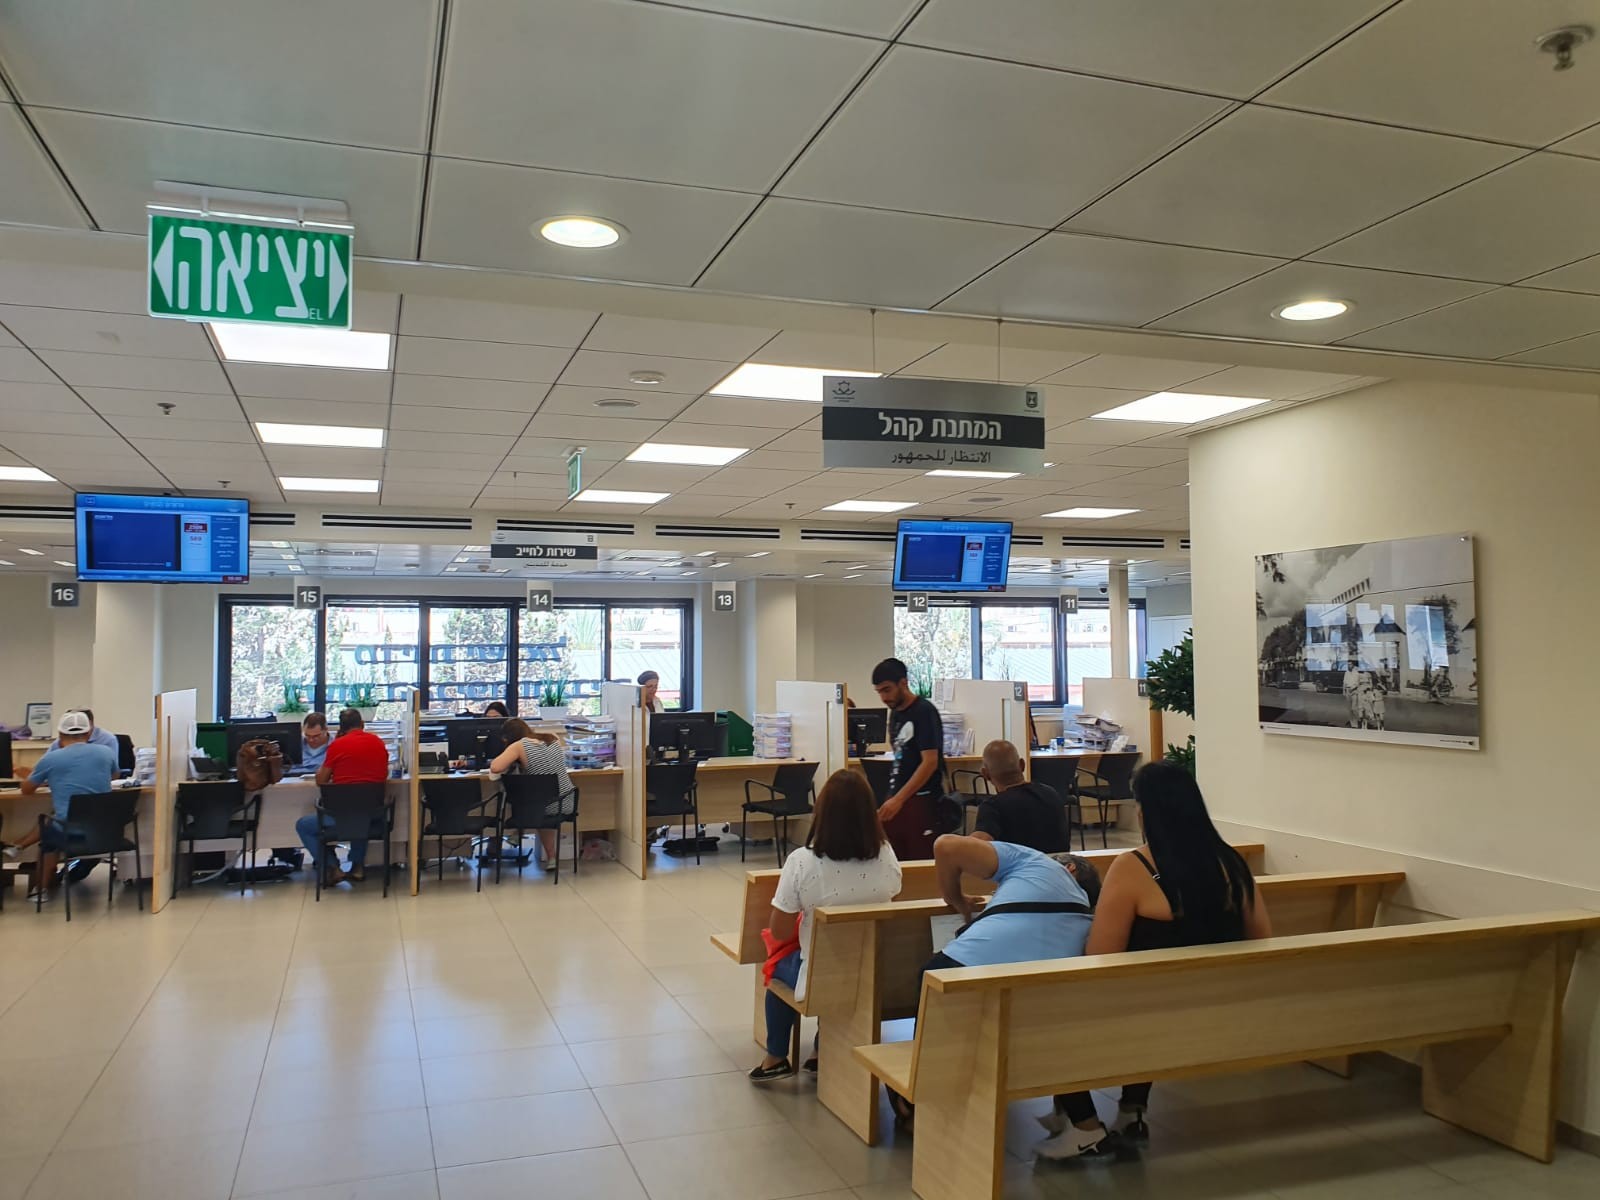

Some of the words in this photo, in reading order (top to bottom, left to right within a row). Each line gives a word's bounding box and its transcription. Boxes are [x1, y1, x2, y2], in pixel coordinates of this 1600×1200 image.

[178, 226, 325, 319] יציאה
[878, 411, 924, 441] קהל
[930, 417, 1002, 441] המתנת
[515, 545, 543, 557] לחייב
[546, 546, 576, 557] שירות
[54, 588, 75, 601] 16
[300, 590, 318, 603] 15
[532, 594, 549, 606] 14
[718, 595, 732, 606] 13
[912, 596, 925, 607] 12
[1065, 599, 1076, 609] 11
[1014, 685, 1023, 697] 12
